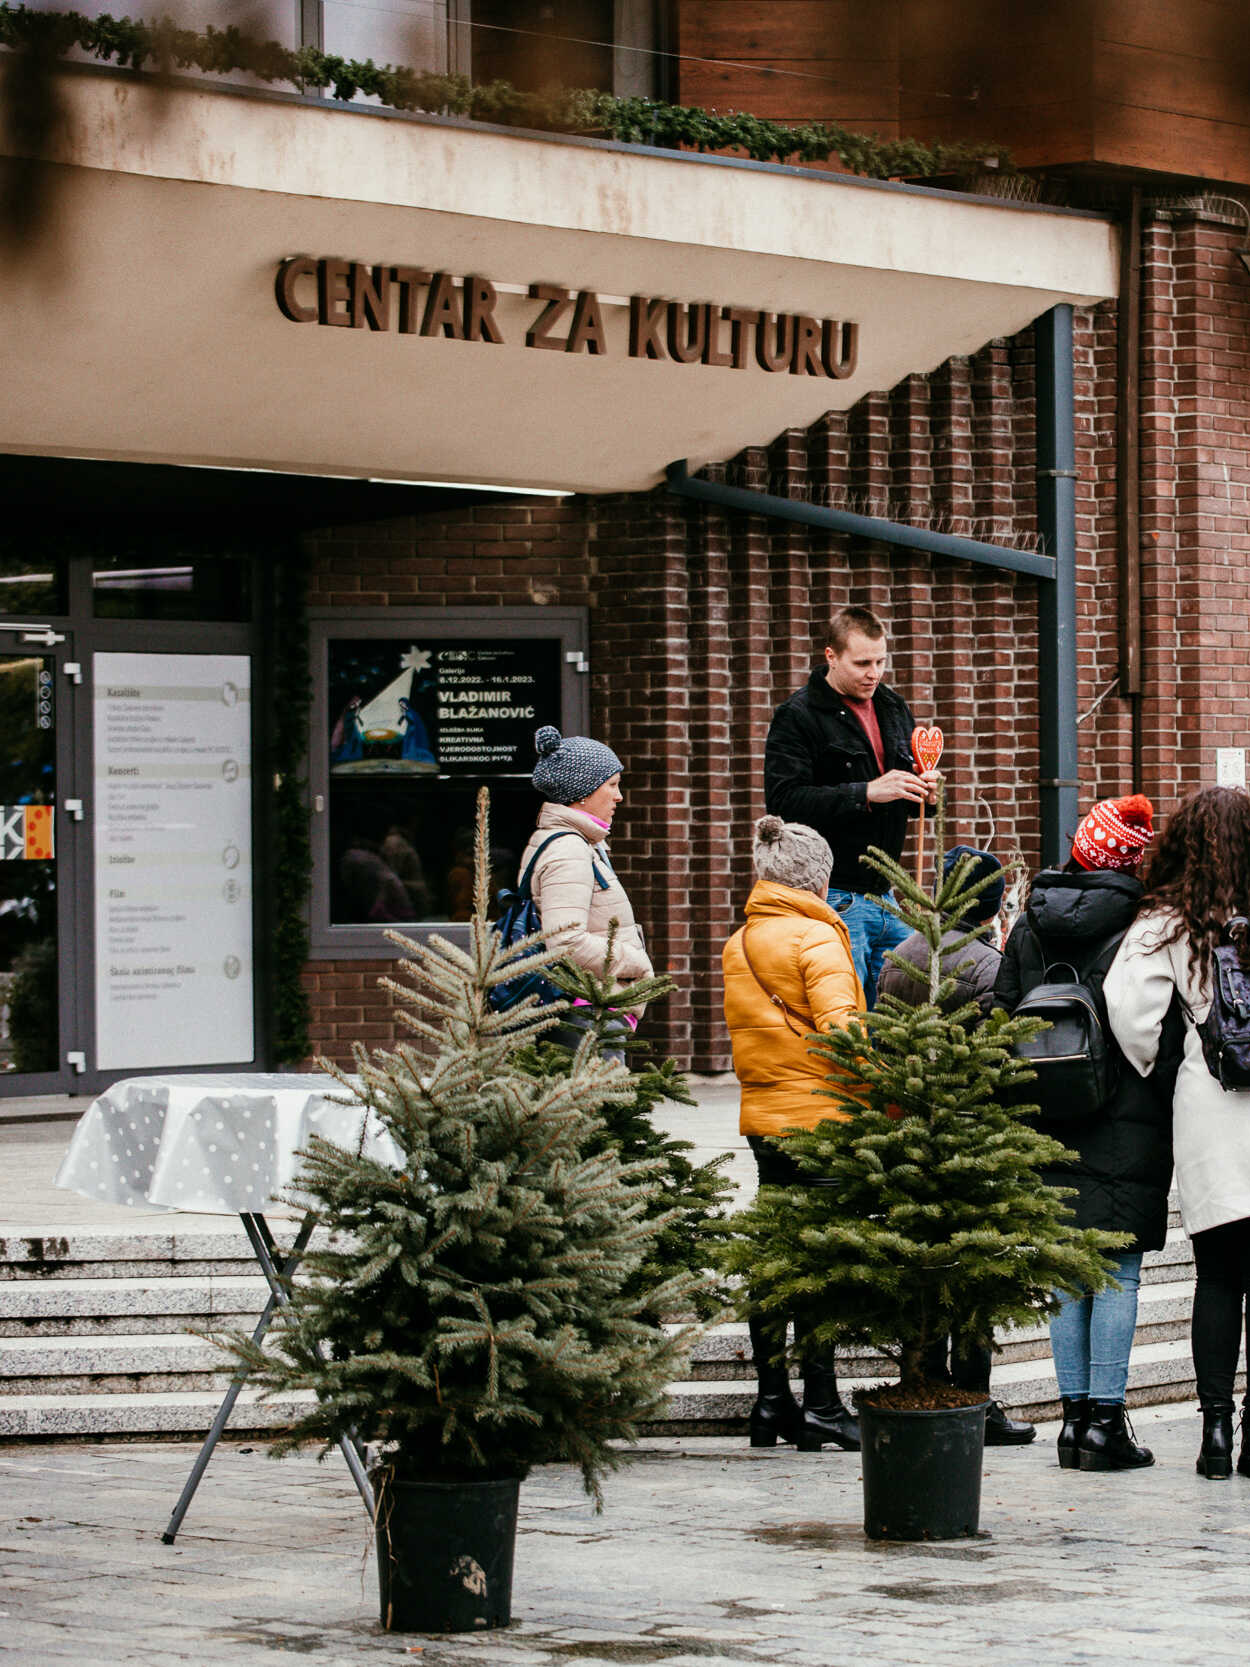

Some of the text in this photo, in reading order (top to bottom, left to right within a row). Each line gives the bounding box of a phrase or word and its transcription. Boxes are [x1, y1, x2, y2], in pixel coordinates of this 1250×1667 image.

[275, 255, 859, 379] CENTAR ZA KULTURU
[439, 692, 511, 702] VLADIMIR
[439, 705, 535, 718] BLAŽANOVIĆ
